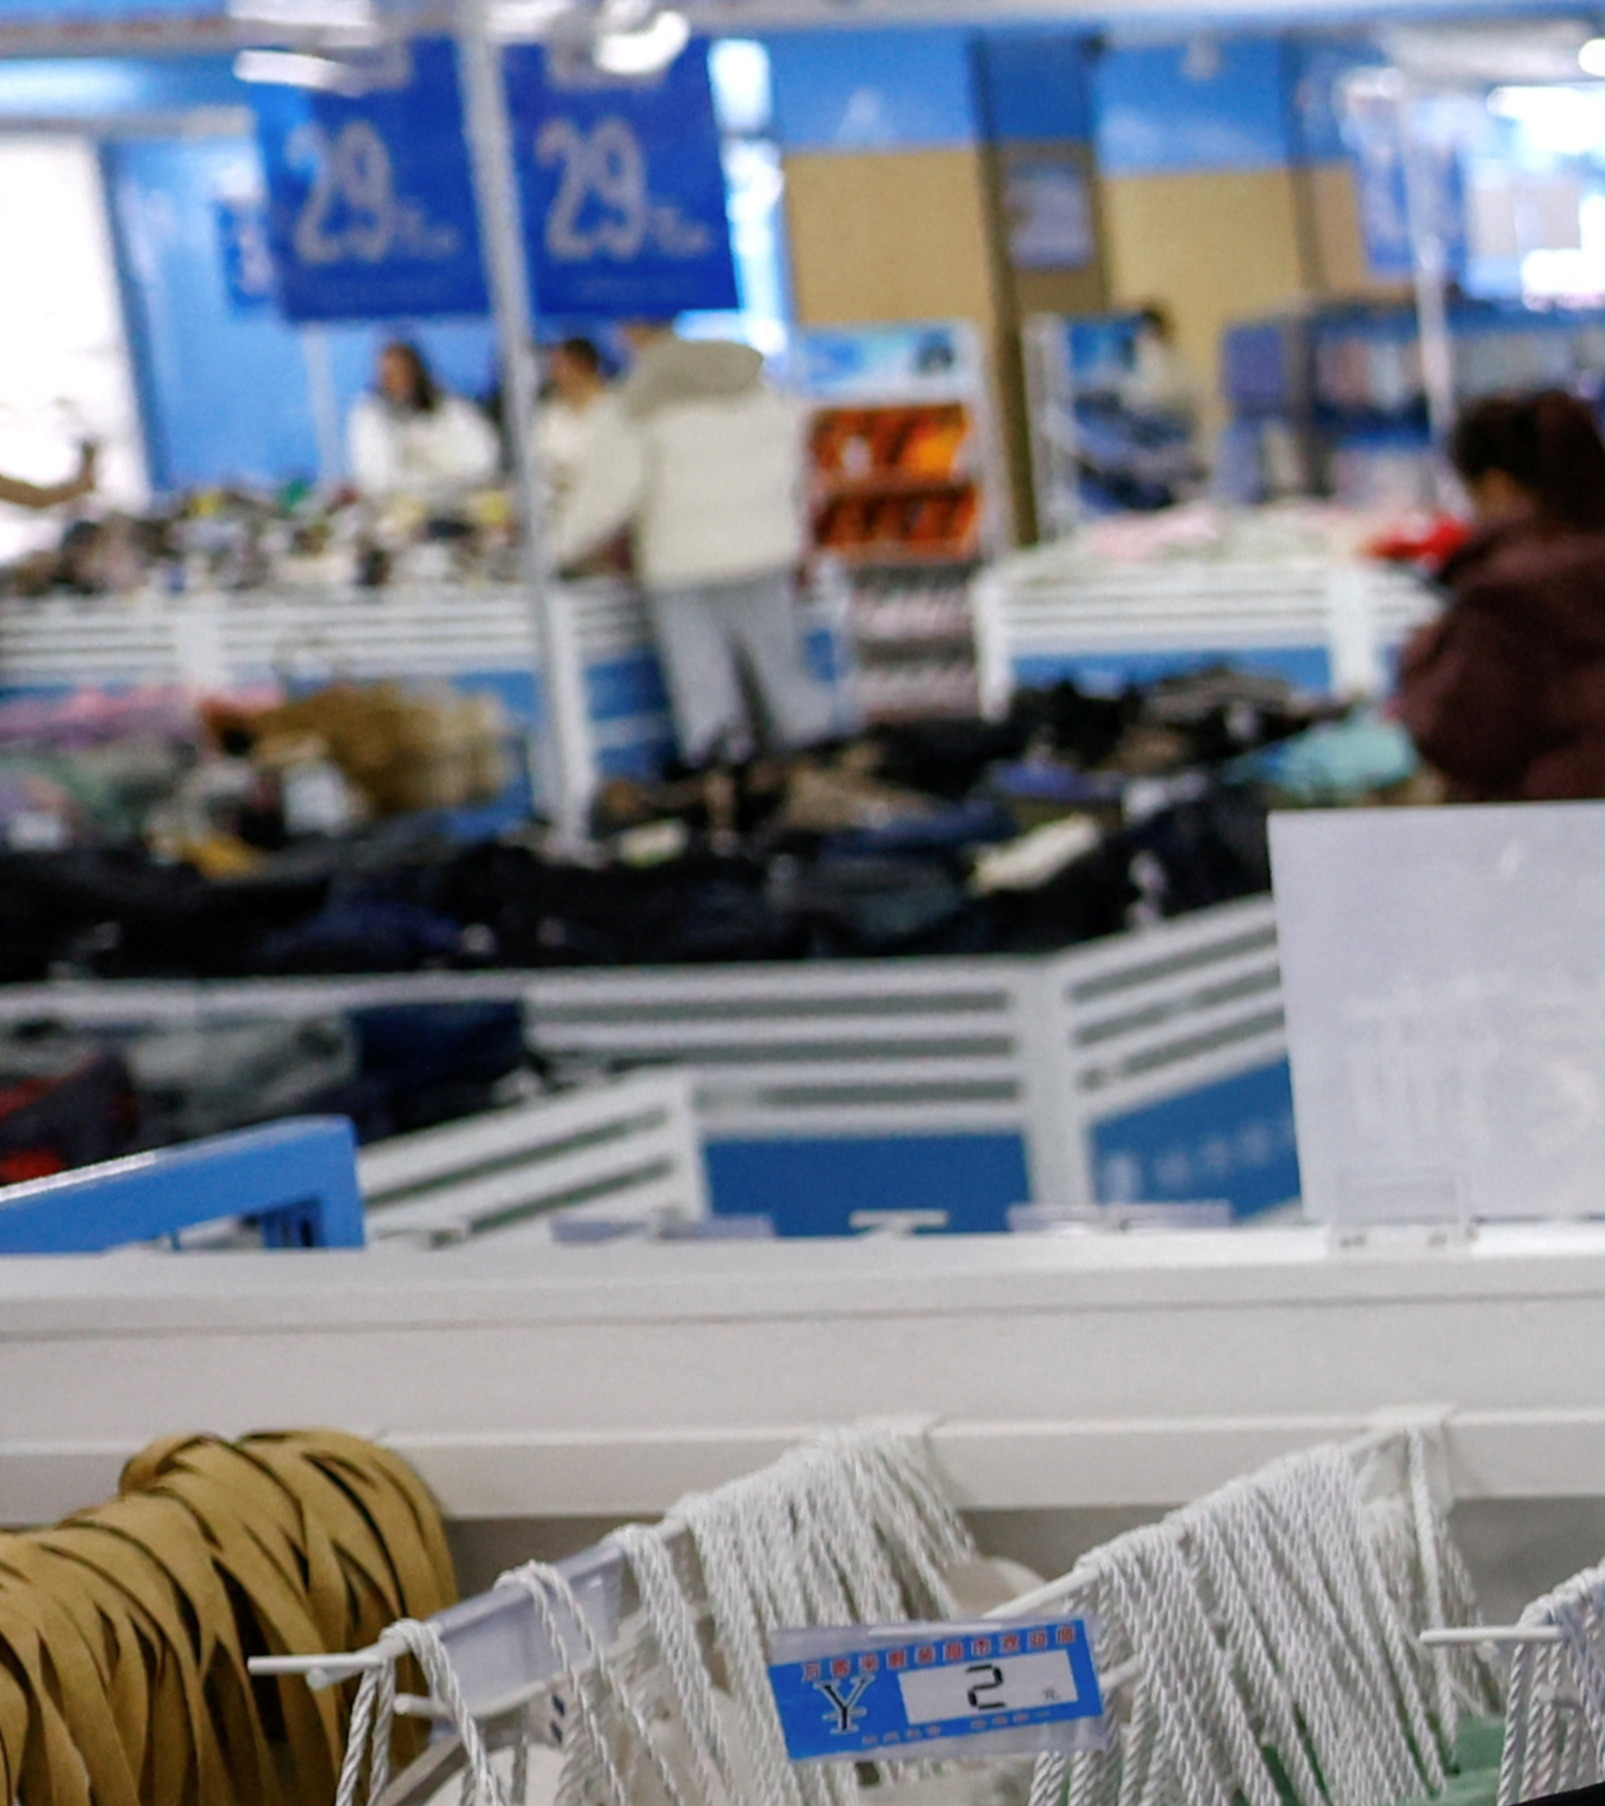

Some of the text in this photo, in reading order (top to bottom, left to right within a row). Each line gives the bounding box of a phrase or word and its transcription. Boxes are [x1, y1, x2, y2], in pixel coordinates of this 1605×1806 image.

[288, 118, 395, 264] 29
[535, 116, 648, 262] 29
[965, 1663, 1006, 1711] 2
